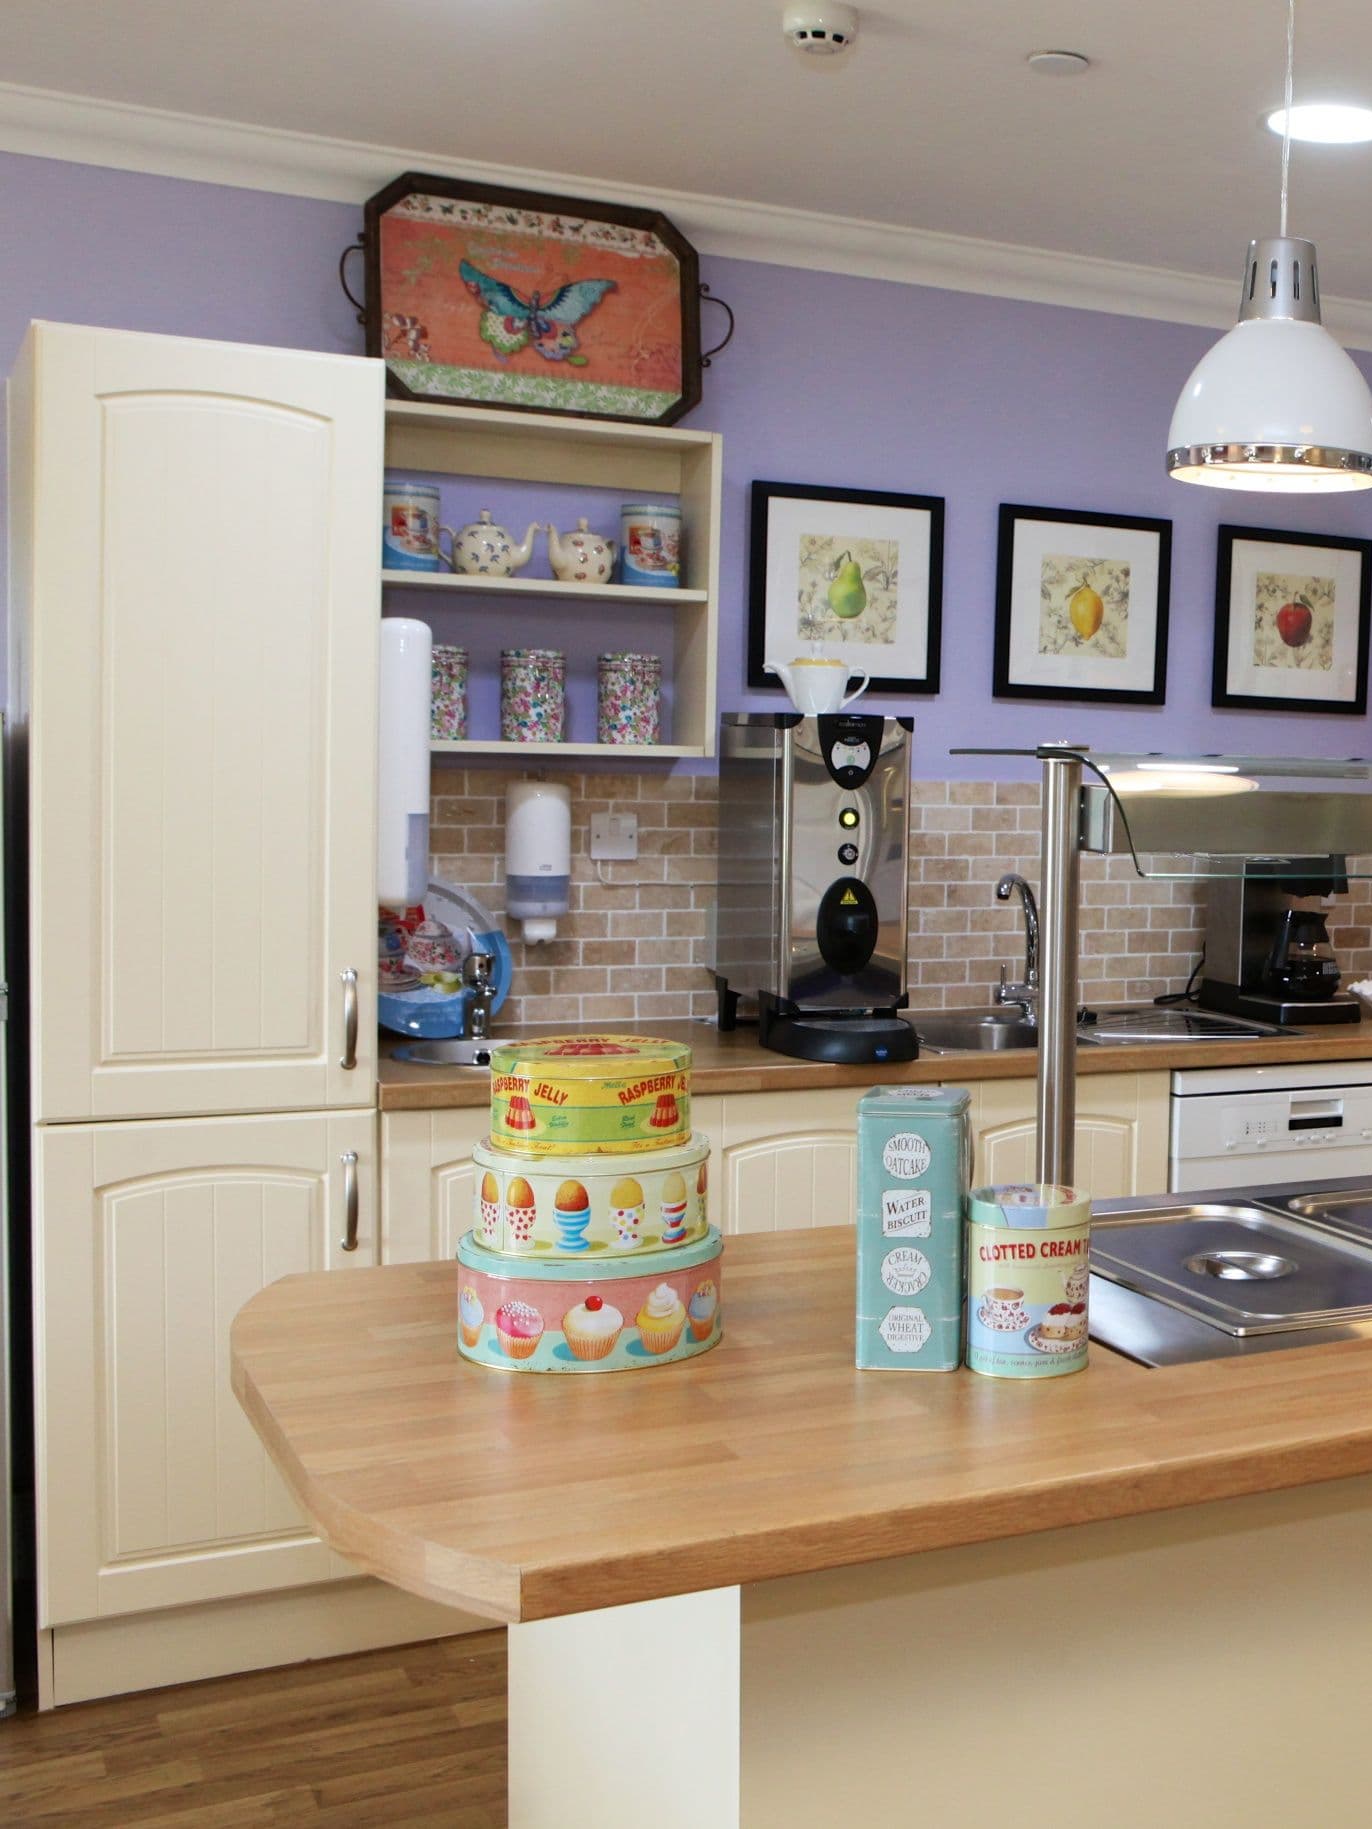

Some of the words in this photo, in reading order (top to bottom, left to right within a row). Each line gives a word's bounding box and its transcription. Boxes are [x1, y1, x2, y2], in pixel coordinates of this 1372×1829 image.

[534, 1083, 568, 1106] JELLY
[618, 1075, 676, 1106] RASPBERRY
[888, 1137, 926, 1153] SMOOTH
[885, 1155, 927, 1175] OATCAKE
[886, 1196, 925, 1215] WATER
[887, 1210, 928, 1231] BISCUIT
[888, 1250, 923, 1266] CREAM
[979, 1243, 1036, 1261] CLOTTED
[1040, 1239, 1081, 1258] CREAM
[886, 1333, 923, 1341] DIGESTIVE
[888, 1322, 923, 1333] WHEAT
